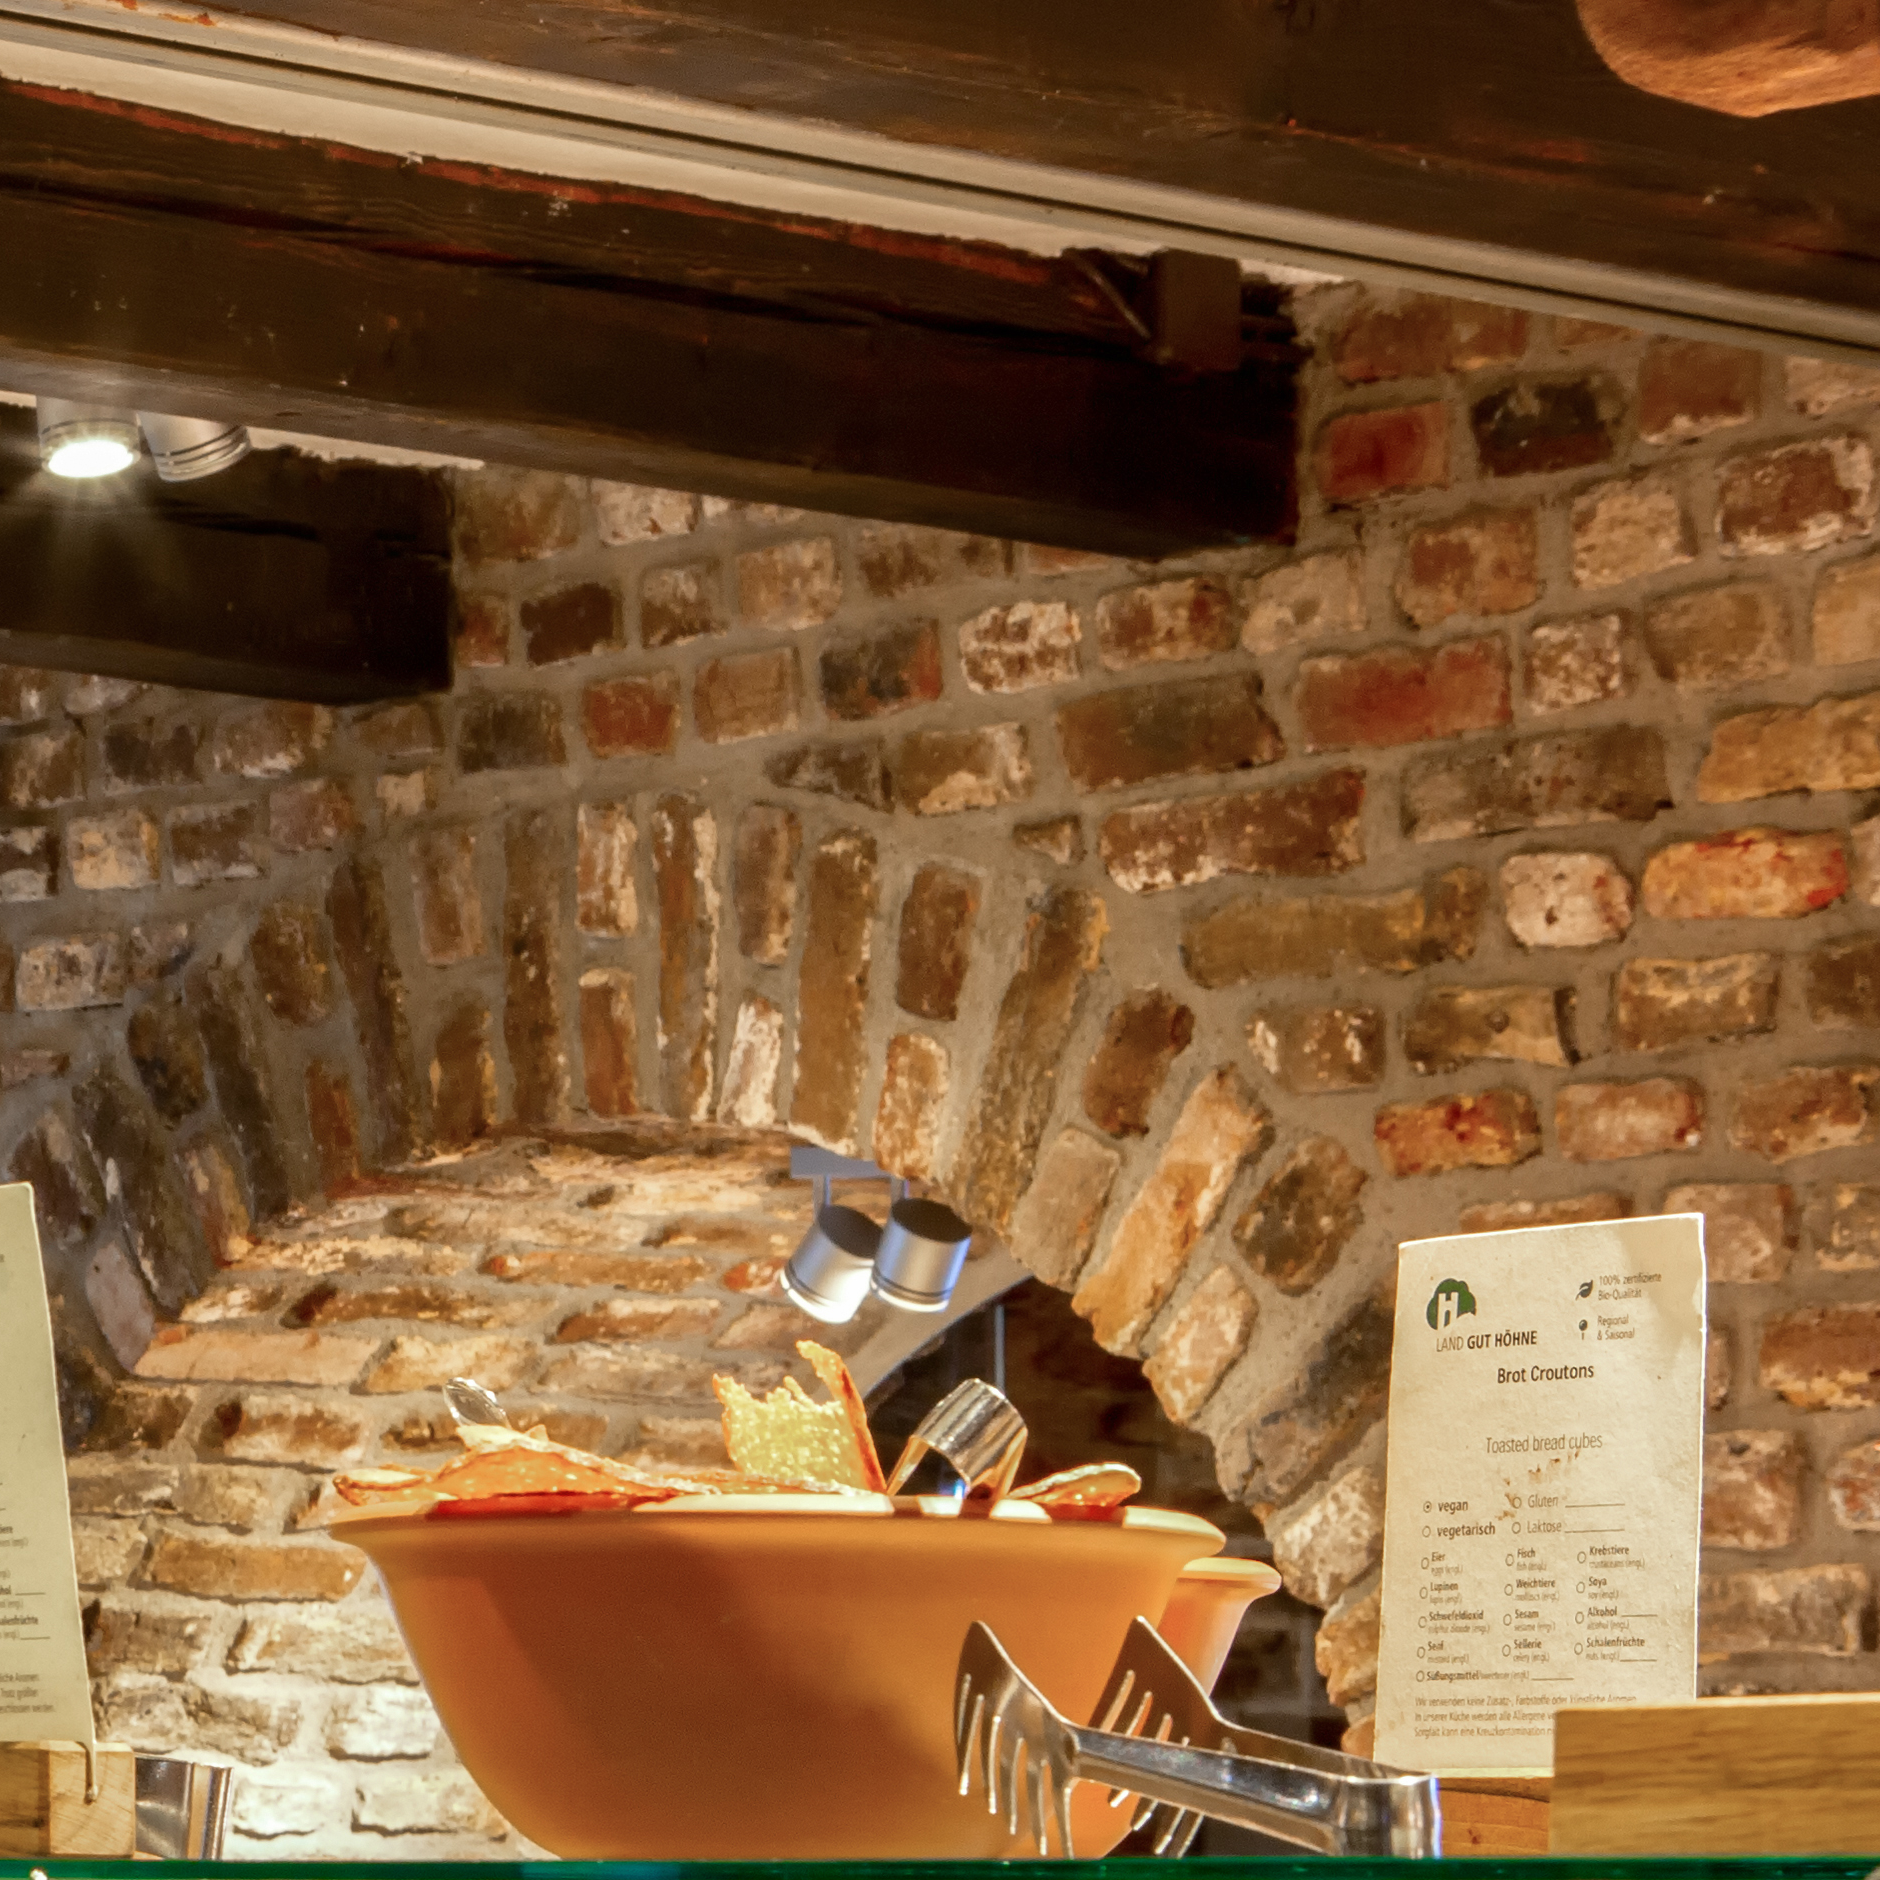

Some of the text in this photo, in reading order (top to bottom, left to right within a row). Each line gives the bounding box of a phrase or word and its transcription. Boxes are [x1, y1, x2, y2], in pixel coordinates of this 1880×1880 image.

[1599, 1272, 1662, 1286] 100% zertifizierte
[1598, 1288, 1642, 1301] Bio-Qualität
[1597, 1314, 1629, 1328] Regional
[1597, 1328, 1635, 1341] & Saisonal
[1436, 1330, 1537, 1352] LAND GUT HÖHNE
[1497, 1364, 1594, 1383] Brot Croutons
[1486, 1432, 1602, 1453] Toasted bread cubes
[1438, 1494, 1559, 1515] vegan Gluten
[1437, 1520, 1562, 1540] vegetarisch Laktose
[1517, 1547, 1536, 1558] Fisch
[1589, 1545, 1629, 1556] Krebstiere
[1432, 1551, 1445, 1562] Eier
[1430, 1582, 1459, 1592] Lupinen
[1516, 1578, 1556, 1589] Weichtiere
[1588, 1576, 1607, 1587] Soya
[1429, 1610, 1485, 1621] Schwefeldioxid
[1515, 1609, 1539, 1620] Sesam
[1587, 1606, 1618, 1617] Alkohol
[1428, 1641, 1444, 1651] Senf
[1514, 1638, 1542, 1649] Sellerie
[1586, 1636, 1645, 1648] Schalenfrüchte
[1426, 1671, 1479, 1684] Süßungsmittel
